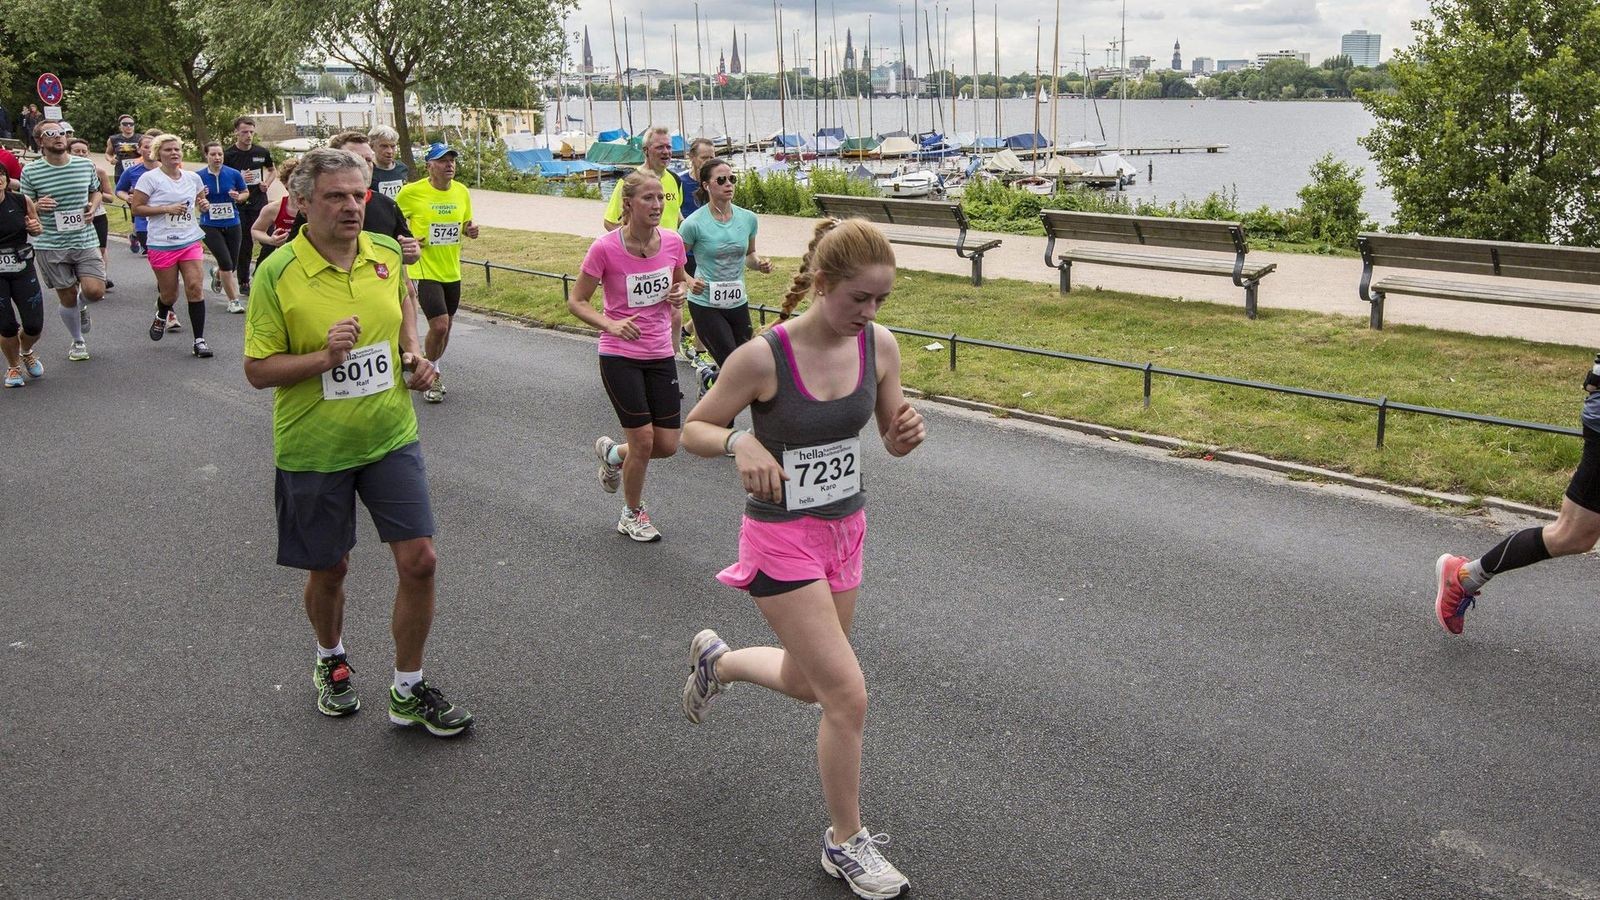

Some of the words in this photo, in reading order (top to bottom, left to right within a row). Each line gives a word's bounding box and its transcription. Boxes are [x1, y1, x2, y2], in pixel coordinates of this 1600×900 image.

[664, 192, 677, 201] ex
[212, 206, 232, 214] 2215
[63, 215, 82, 225] 208
[169, 212, 192, 221] 7749
[433, 227, 459, 238] 5742
[633, 276, 670, 296] 4053
[714, 288, 742, 301] 8140
[331, 354, 388, 383] 6016
[356, 379, 370, 387] Ralf
[799, 449, 824, 461] hella
[794, 452, 856, 488] 7232
[820, 483, 837, 493] Karo
[799, 496, 815, 505] hella
